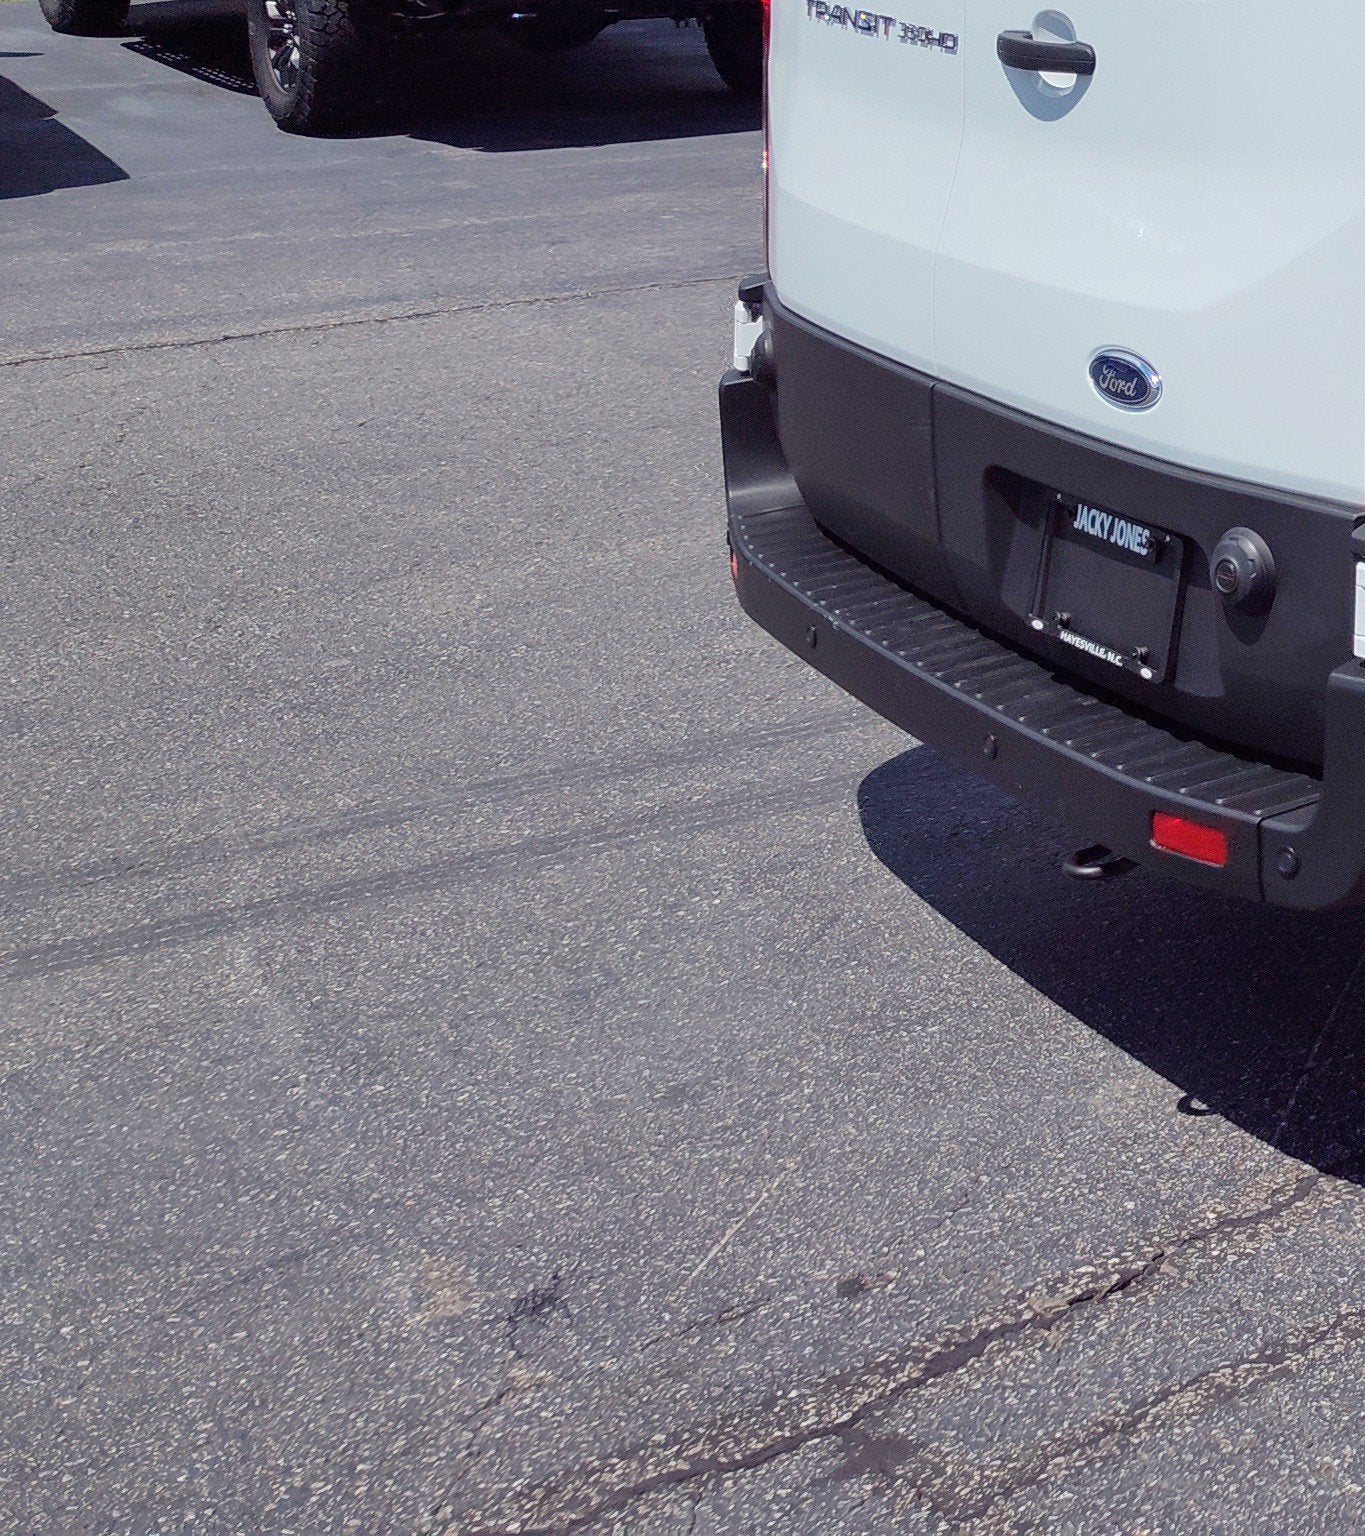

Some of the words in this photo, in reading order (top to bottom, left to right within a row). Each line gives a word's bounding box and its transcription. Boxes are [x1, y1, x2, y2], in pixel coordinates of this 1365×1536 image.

[1100, 364, 1138, 397] Ford
[1073, 503, 1113, 540] JACKY
[1110, 517, 1151, 556] JONES
